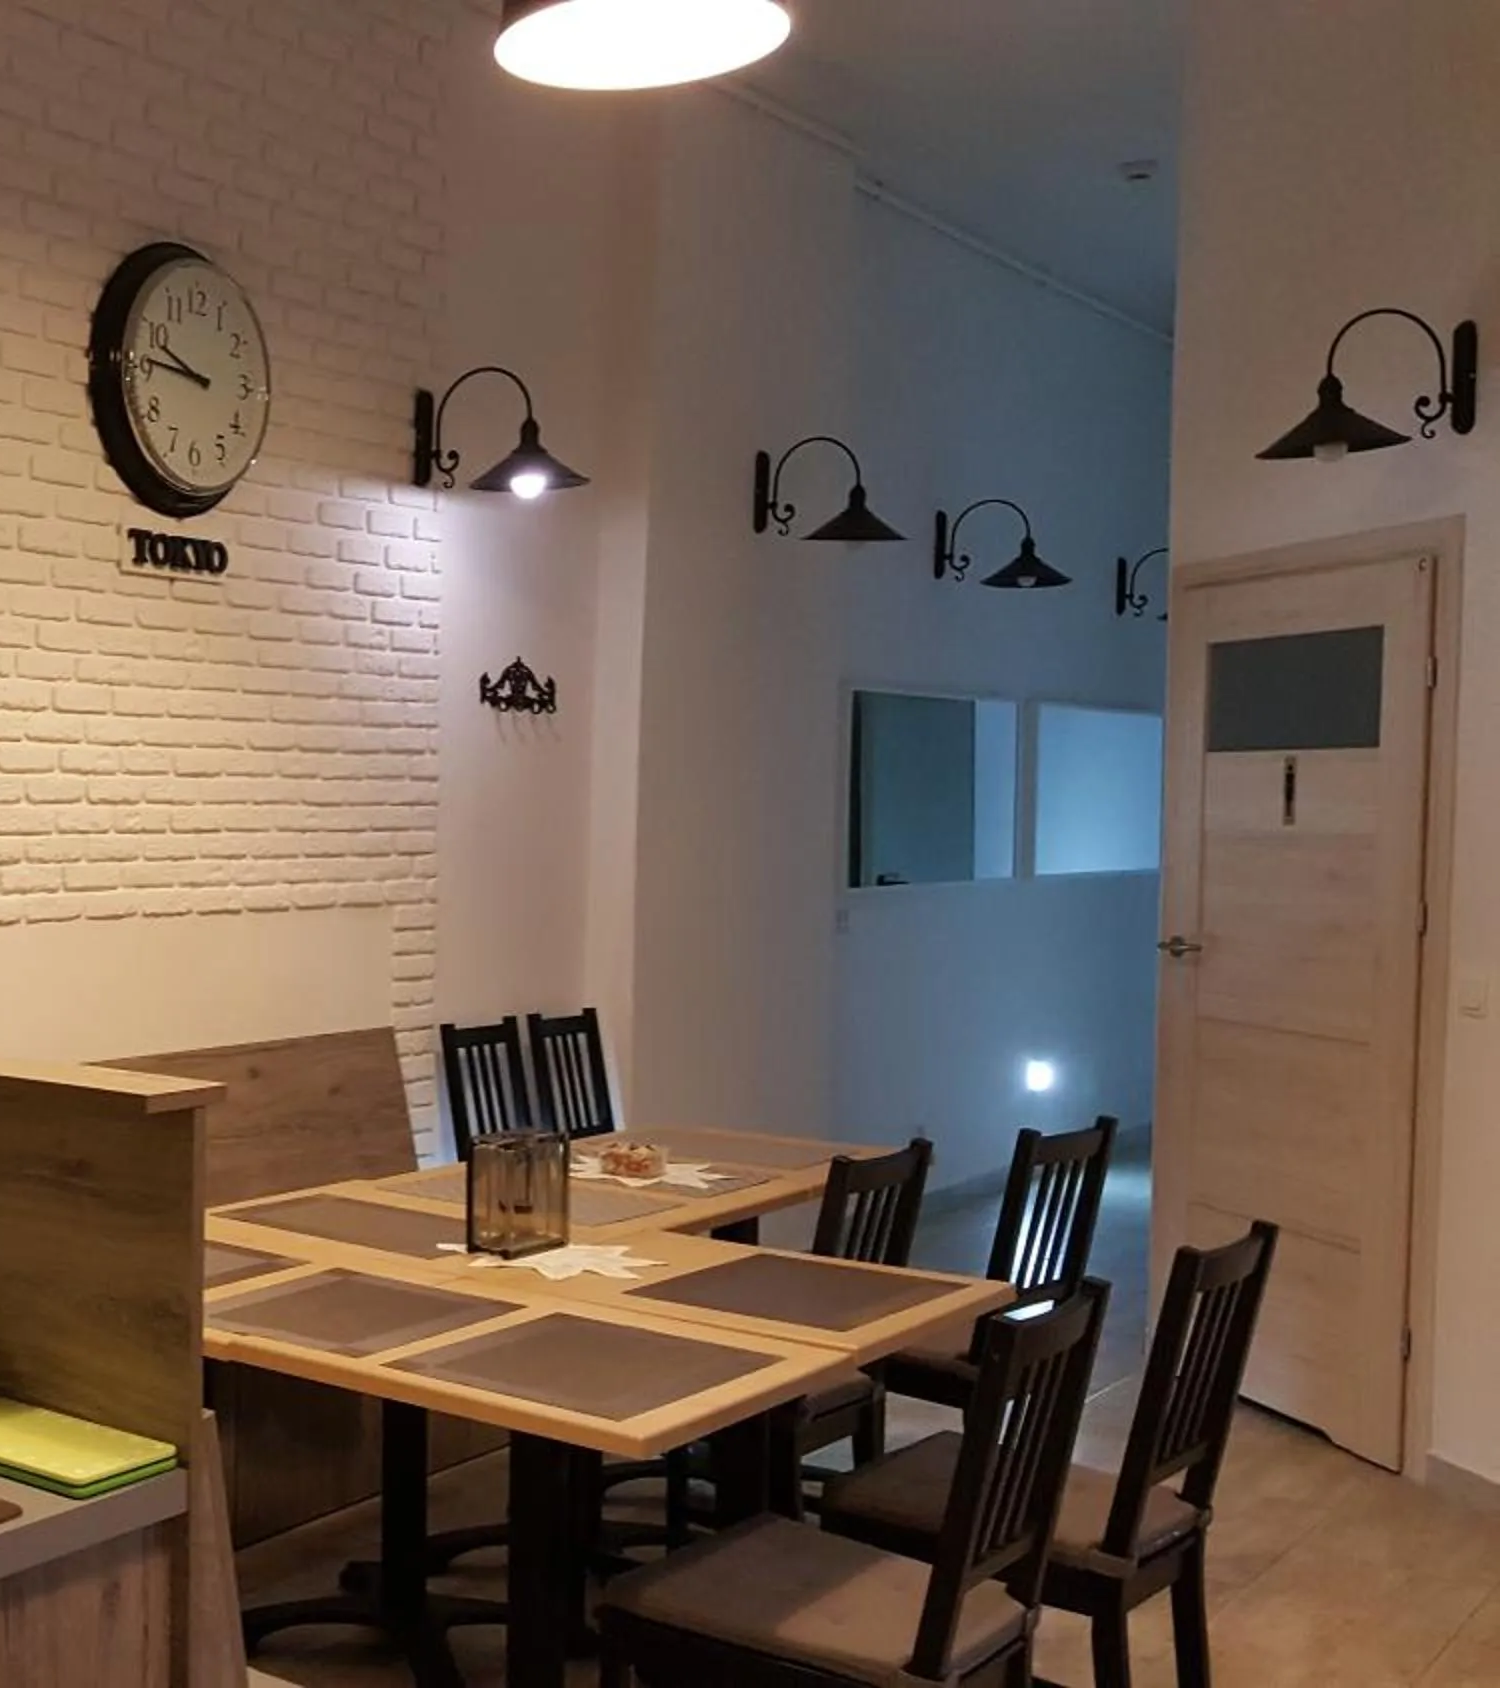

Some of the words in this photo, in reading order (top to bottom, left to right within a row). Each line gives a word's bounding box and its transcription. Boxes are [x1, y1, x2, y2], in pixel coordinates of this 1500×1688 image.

[167, 295, 183, 325] 11
[187, 287, 207, 317] 12
[149, 321, 169, 351] 10
[230, 332, 242, 360] 2
[238, 373, 250, 401] 3
[147, 395, 161, 423] 8
[229, 409, 242, 436] 4
[167, 425, 179, 453] 7
[215, 434, 226, 462] 5
[188, 440, 202, 467] 6
[127, 527, 229, 574] TOKYO
